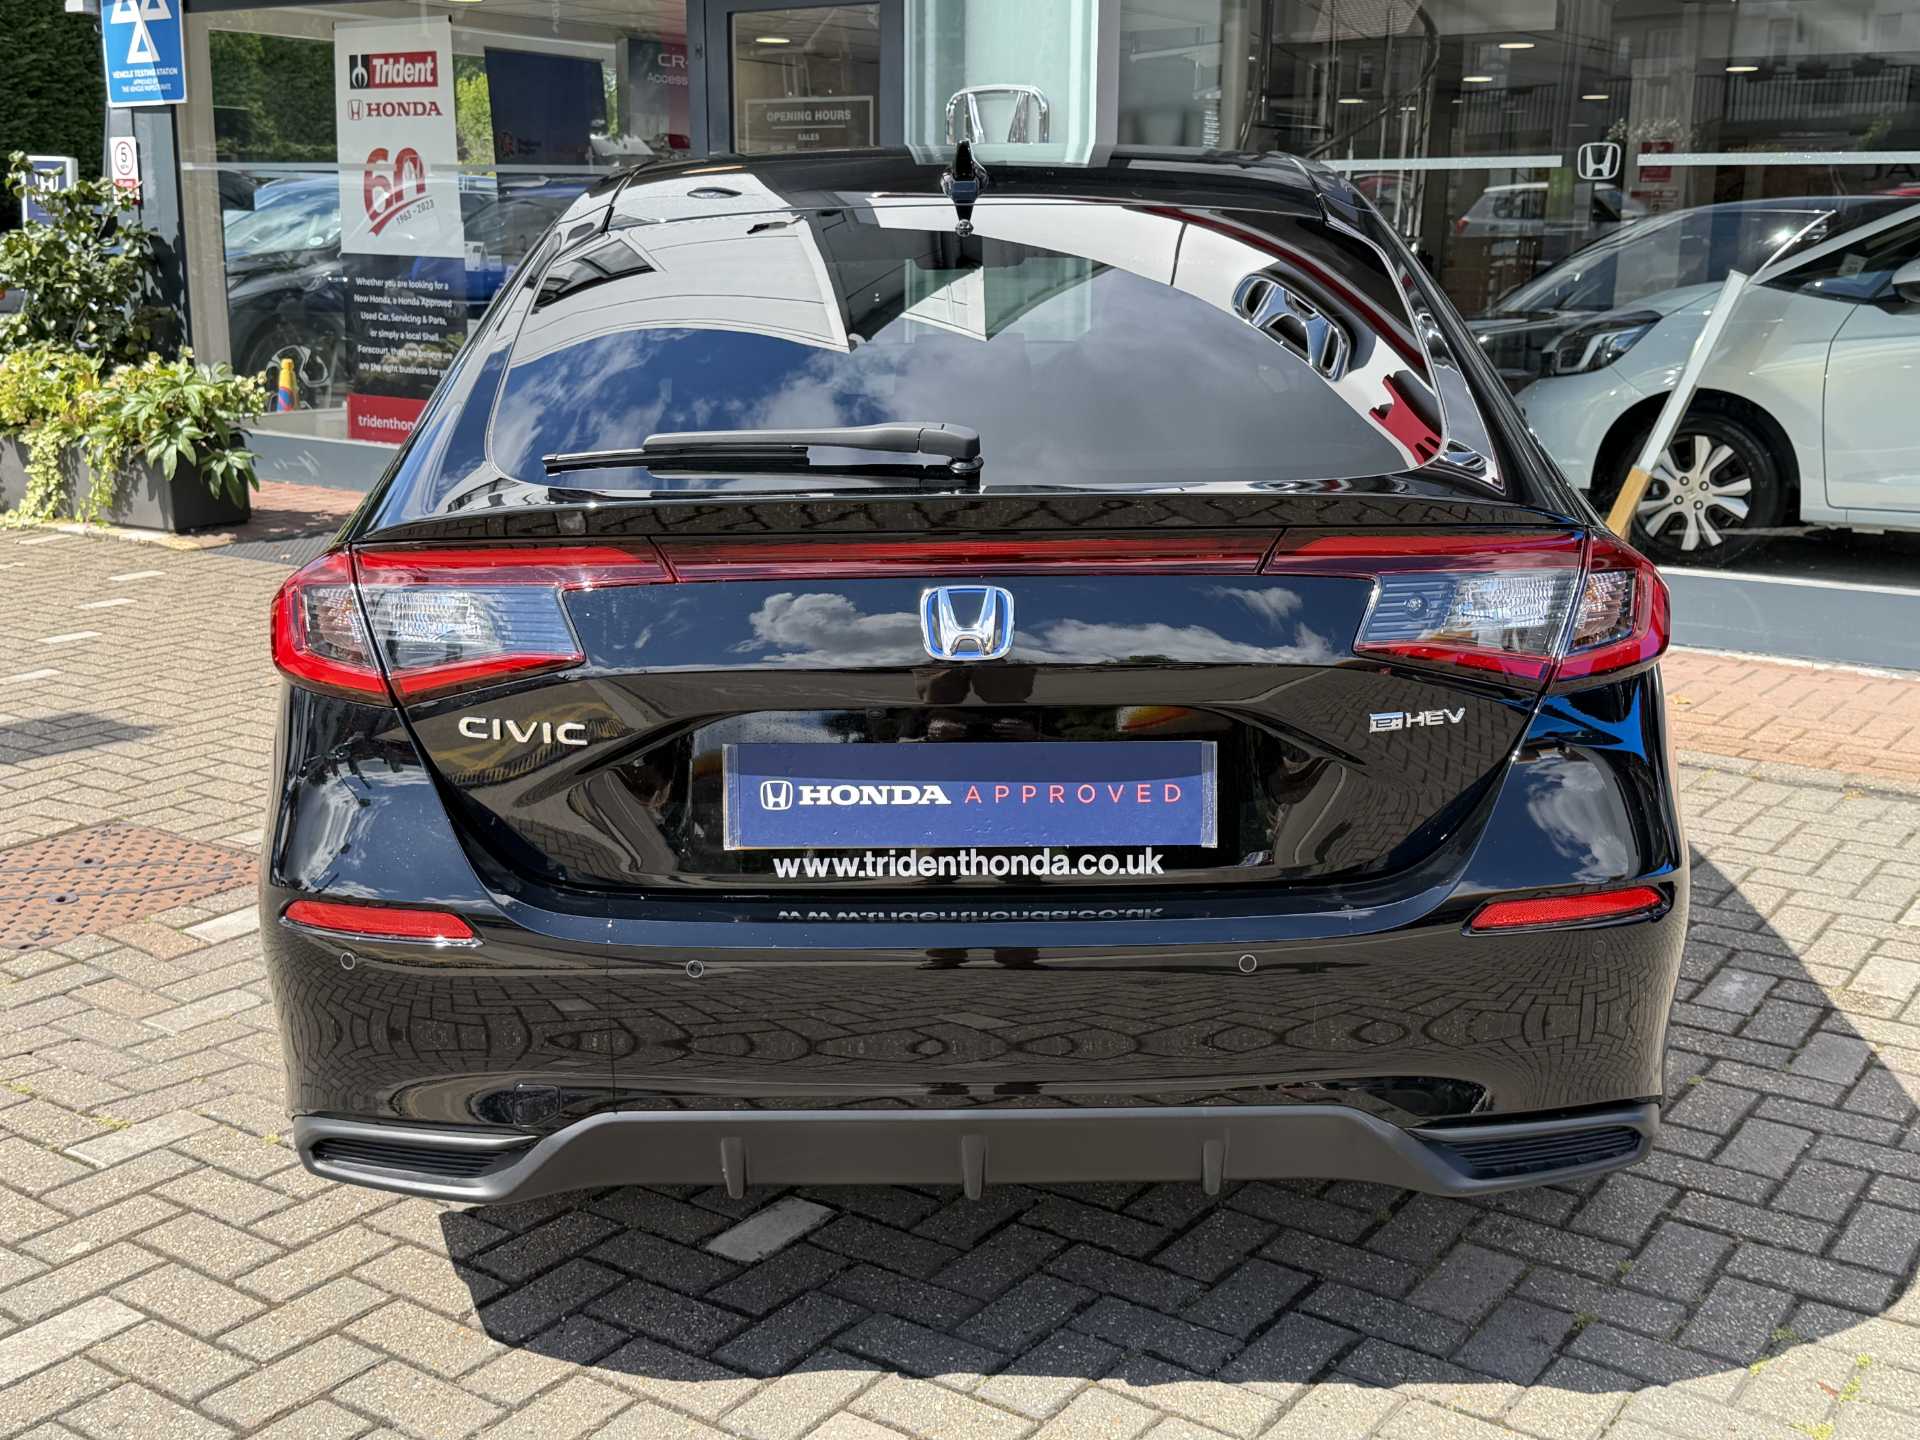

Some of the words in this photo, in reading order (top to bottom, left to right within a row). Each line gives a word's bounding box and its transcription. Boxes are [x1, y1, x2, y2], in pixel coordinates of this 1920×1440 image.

[372, 56, 434, 84] Trident
[366, 101, 443, 117] HONDA
[766, 110, 812, 122] OPENING
[815, 109, 851, 121] HOURS
[798, 133, 819, 141] SALES
[120, 146, 128, 163] 5
[355, 277, 384, 288] Whether
[384, 279, 396, 289] you
[397, 280, 408, 289] are
[408, 279, 433, 291] looking
[434, 281, 443, 290] for
[444, 283, 449, 291] a
[353, 294, 369, 303] New
[369, 294, 392, 305] Honda,
[398, 296, 420, 306] Honda
[421, 298, 452, 309] Approved
[360, 311, 377, 321] Used
[391, 313, 421, 326] Servicing
[422, 315, 428, 323] &
[428, 315, 448, 326] Parts,
[369, 330, 378, 338] or
[378, 329, 400, 340] simply
[405, 331, 421, 340] local
[422, 332, 439, 341] Shell
[357, 344, 391, 356] Forecourt,
[370, 363, 381, 372] the
[399, 366, 428, 376] business
[428, 368, 439, 376] for
[457, 715, 589, 746] CIVIC
[798, 784, 952, 806] HONDA
[964, 784, 1182, 804] APPROVED
[772, 847, 1165, 878] www.tridenthonda.co.uk
